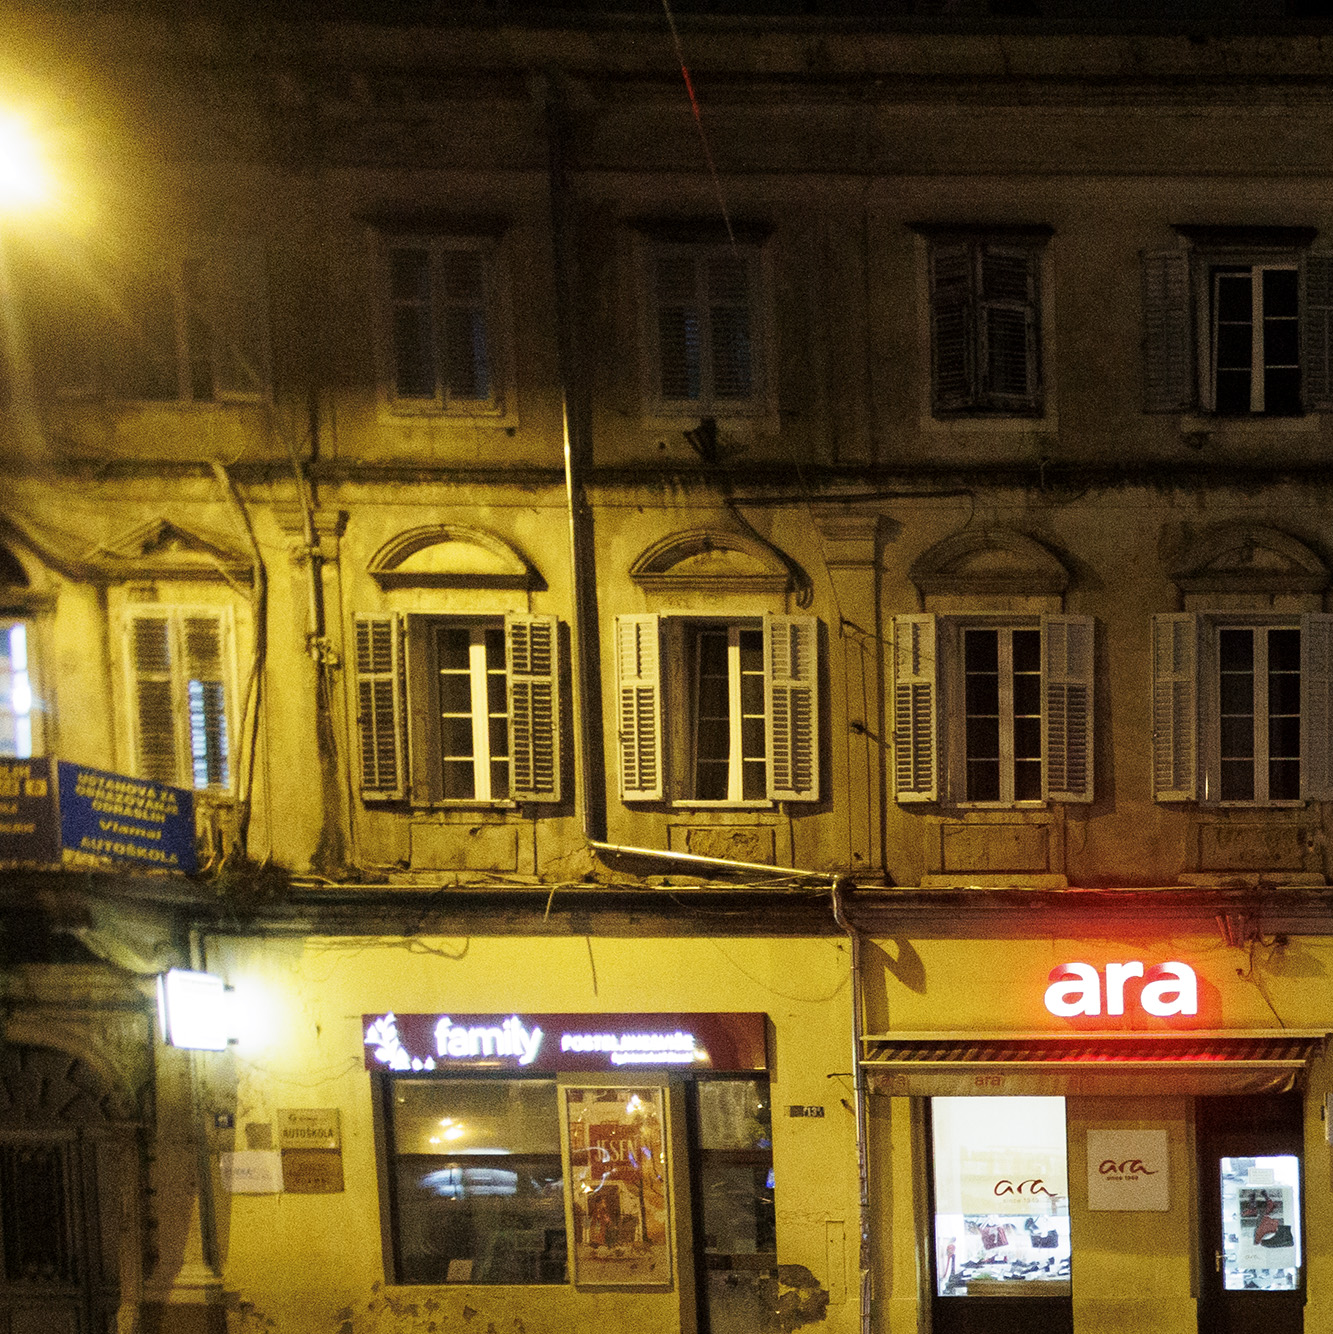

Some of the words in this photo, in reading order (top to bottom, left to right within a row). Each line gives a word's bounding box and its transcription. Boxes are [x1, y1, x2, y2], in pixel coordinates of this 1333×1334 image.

[1044, 961, 1198, 1017] ara
[434, 1014, 545, 1066] family
[1098, 1159, 1158, 1175] ara
[994, 1179, 1058, 1197] ara
